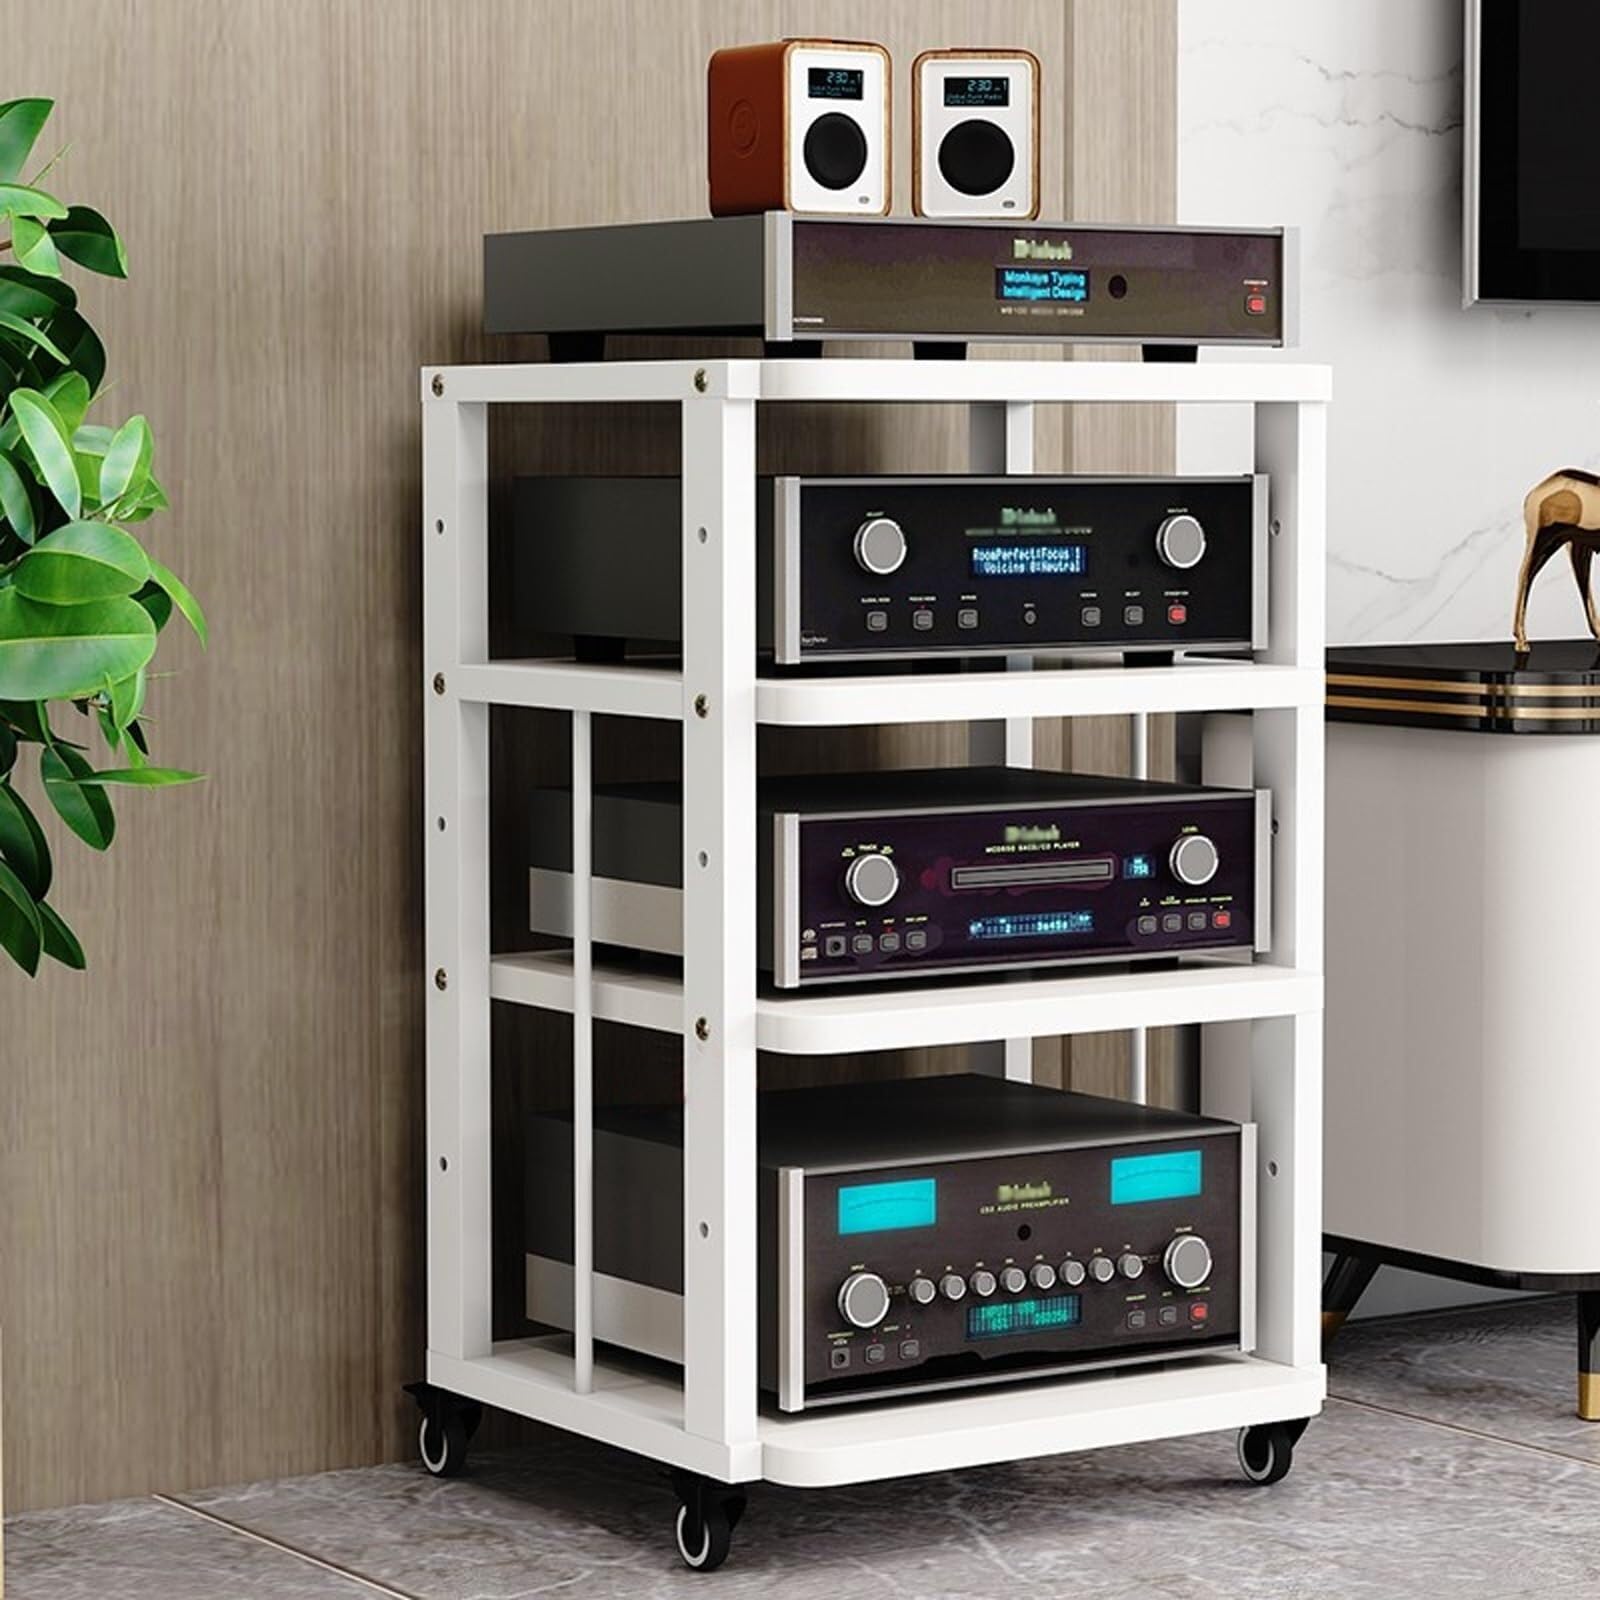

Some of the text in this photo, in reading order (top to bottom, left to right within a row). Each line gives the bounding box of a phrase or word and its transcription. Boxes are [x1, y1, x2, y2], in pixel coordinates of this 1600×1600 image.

[1050, 271, 1085, 287] Typing
[1003, 286, 1086, 301] Intelligent Design
[983, 561, 1025, 573] Voicing
[1053, 841, 1080, 849] PLAYER
[997, 1202, 1019, 1212] AUDIO
[1021, 1198, 1070, 1209] PREAMPLIFIER
